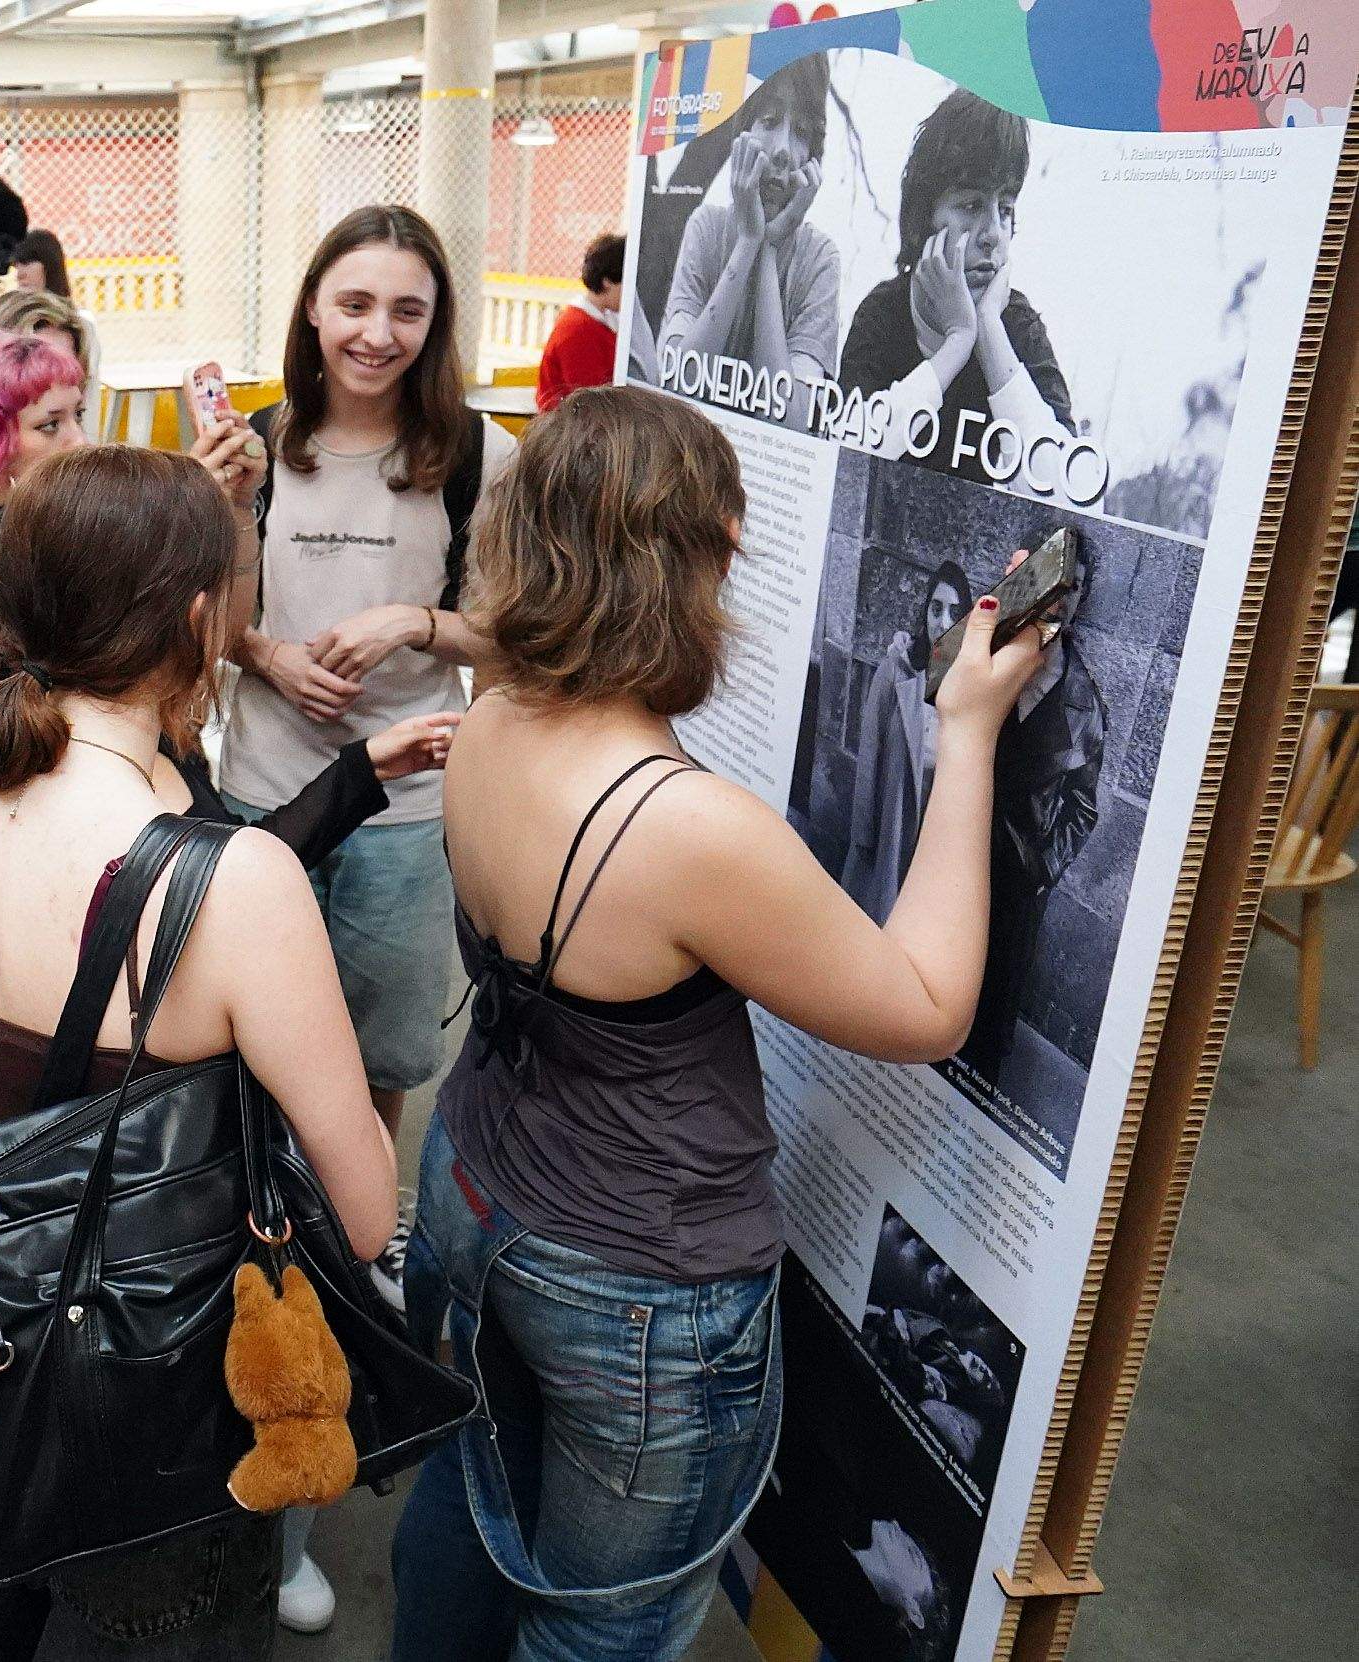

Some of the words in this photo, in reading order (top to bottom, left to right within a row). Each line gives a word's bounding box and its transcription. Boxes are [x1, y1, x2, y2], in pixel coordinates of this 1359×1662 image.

[805, 377, 893, 448] TRAS
[903, 407, 941, 459] O
[951, 408, 1110, 507] FOCO
[996, 1150, 1015, 1174] para
[1017, 1170, 1055, 1208] explorar
